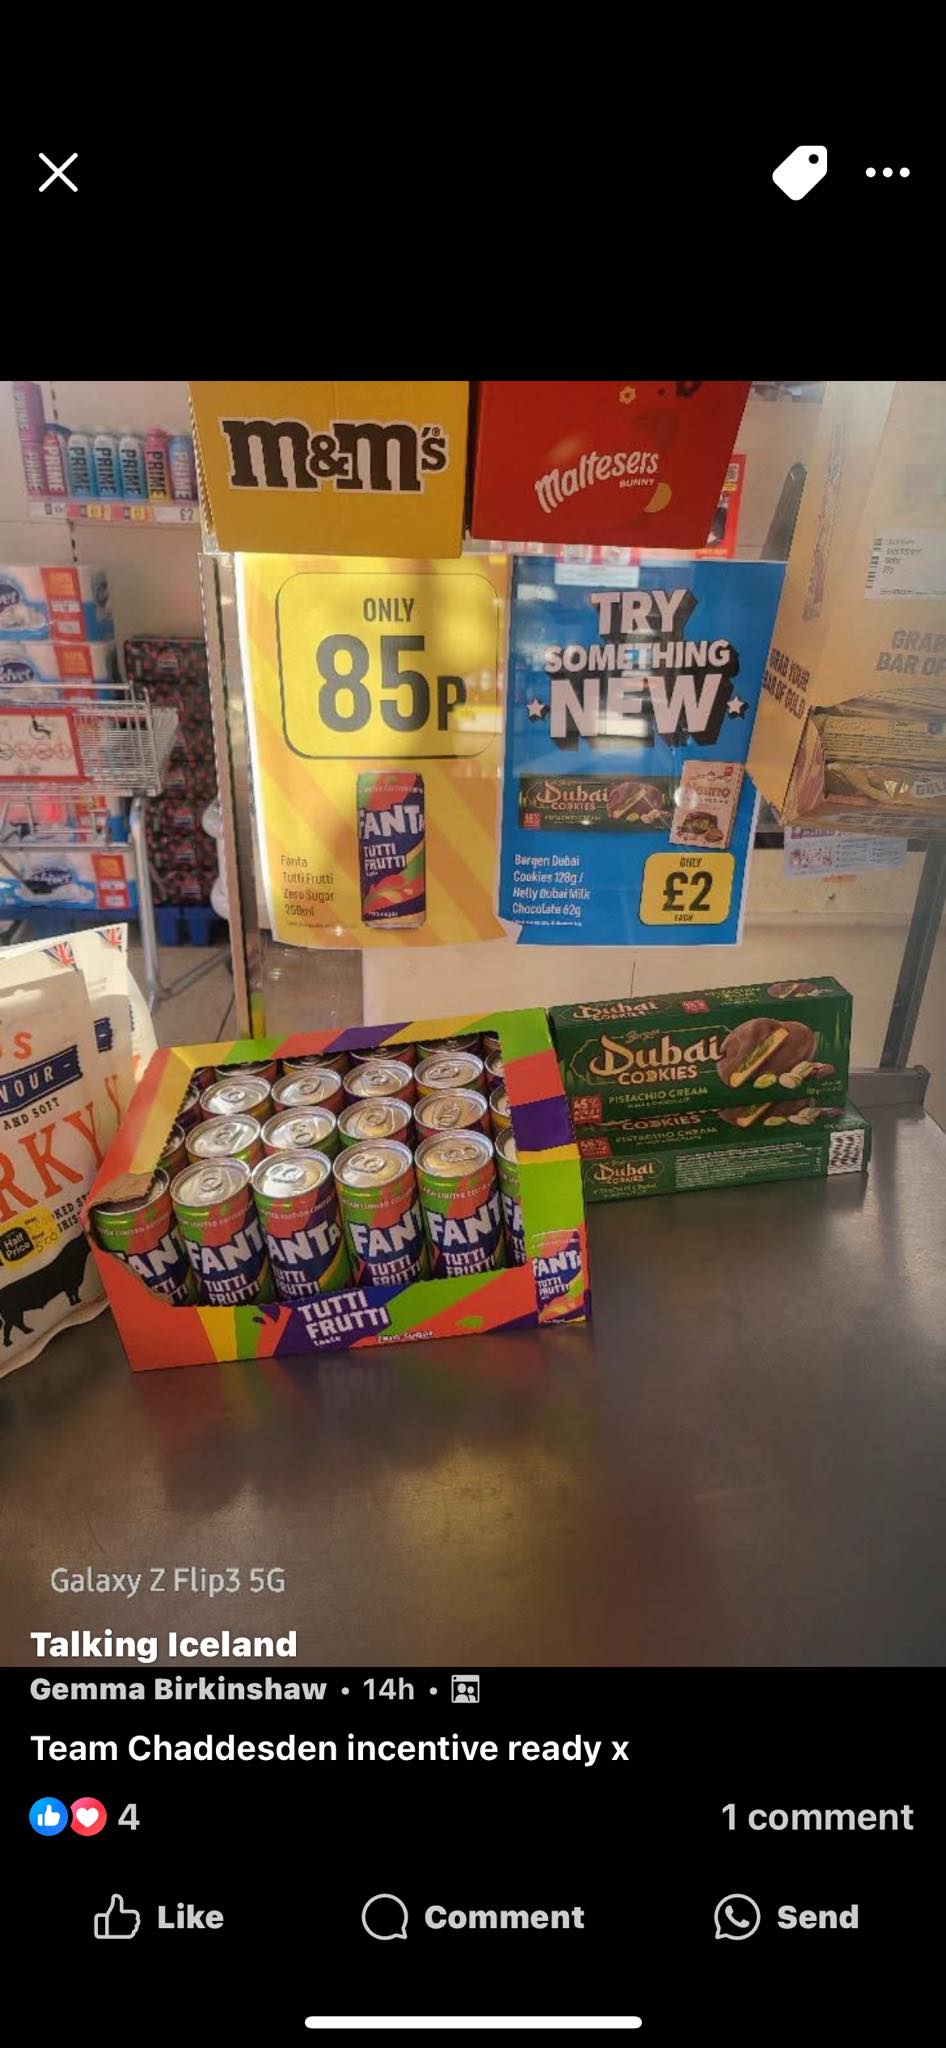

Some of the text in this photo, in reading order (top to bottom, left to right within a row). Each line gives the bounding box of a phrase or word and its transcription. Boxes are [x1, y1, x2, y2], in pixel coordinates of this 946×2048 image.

[69, 447, 90, 494] PRIME
[95, 447, 116, 494] PRIME
[121, 449, 141, 495] PRIME
[146, 451, 167, 496] PRIME
[535, 451, 660, 514] Maltesers
[619, 478, 656, 489] BUNNY
[363, 597, 415, 622] ONLY
[591, 588, 688, 636] TRY
[544, 639, 731, 673] SOMETHING
[550, 673, 723, 738] NEW
[536, 780, 608, 803] Dubai
[363, 843, 396, 858] TUTTI
[280, 855, 308, 868] Fanta
[364, 855, 406, 871] FRUTTI
[552, 854, 579, 867] Dubai
[679, 857, 702, 868] ONLY
[283, 871, 335, 885] Tutti Frutti
[513, 870, 552, 884] Cookies
[554, 871, 577, 886] 128g
[283, 888, 335, 904] Zero Sugar
[539, 887, 568, 900] Dubai
[568, 888, 591, 900] Milk
[661, 870, 714, 912] £2
[285, 904, 315, 917] 250ml
[512, 902, 582, 918] Chocolate 62g
[572, 1000, 660, 1019] Dubai
[589, 1034, 723, 1077] Dubai
[617, 1065, 698, 1086] COOKIES
[608, 1086, 708, 1104] PISTACHIO CREAM
[3, 1097, 61, 1131] AND SOFT
[621, 1114, 702, 1131] COOKIES
[593, 1162, 655, 1180] Dubai
[51, 1203, 74, 1219] KED
[3, 1230, 24, 1248] Half
[263, 1220, 341, 1264] ANTA
[6, 1241, 31, 1260] Price
[443, 1247, 486, 1266] TUTTI
[368, 1254, 411, 1276] TUTTI
[204, 1273, 247, 1293] TUTTI
[208, 1281, 261, 1305] FRUTTI
[297, 1289, 369, 1323] TUTTI
[305, 1306, 390, 1340] FRUTTI
